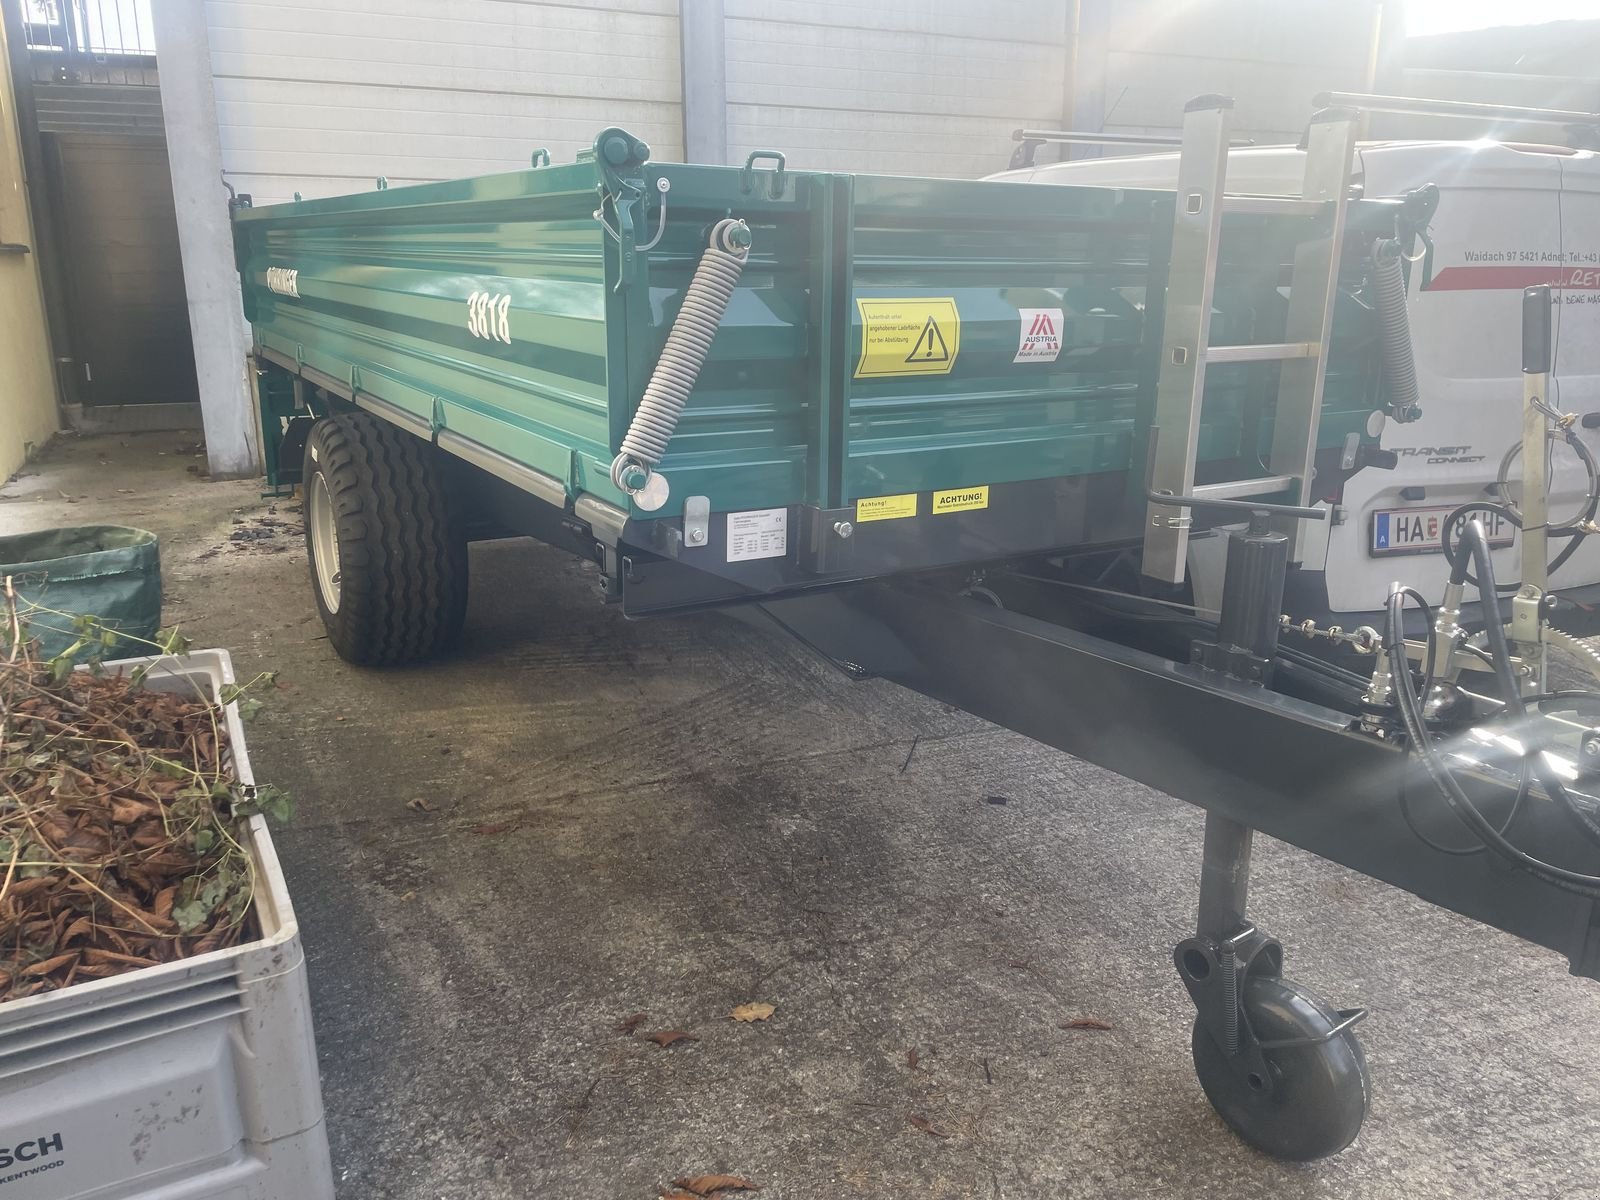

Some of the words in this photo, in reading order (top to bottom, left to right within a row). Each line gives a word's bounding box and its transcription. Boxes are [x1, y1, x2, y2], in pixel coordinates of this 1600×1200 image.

[1464, 251, 1504, 261] Waidach
[1506, 251, 1517, 261] 97
[1520, 251, 1539, 261] 5421
[467, 291, 512, 345] 3818
[1390, 445, 1472, 457] TRANSIT
[1427, 455, 1486, 465] CONNECT
[860, 500, 887, 508] Achtung!
[940, 492, 982, 504] ACHTUNG!
[1396, 516, 1424, 543] HA
[1379, 535, 1386, 544] A
[0, 1159, 64, 1185] KENTWOOD
